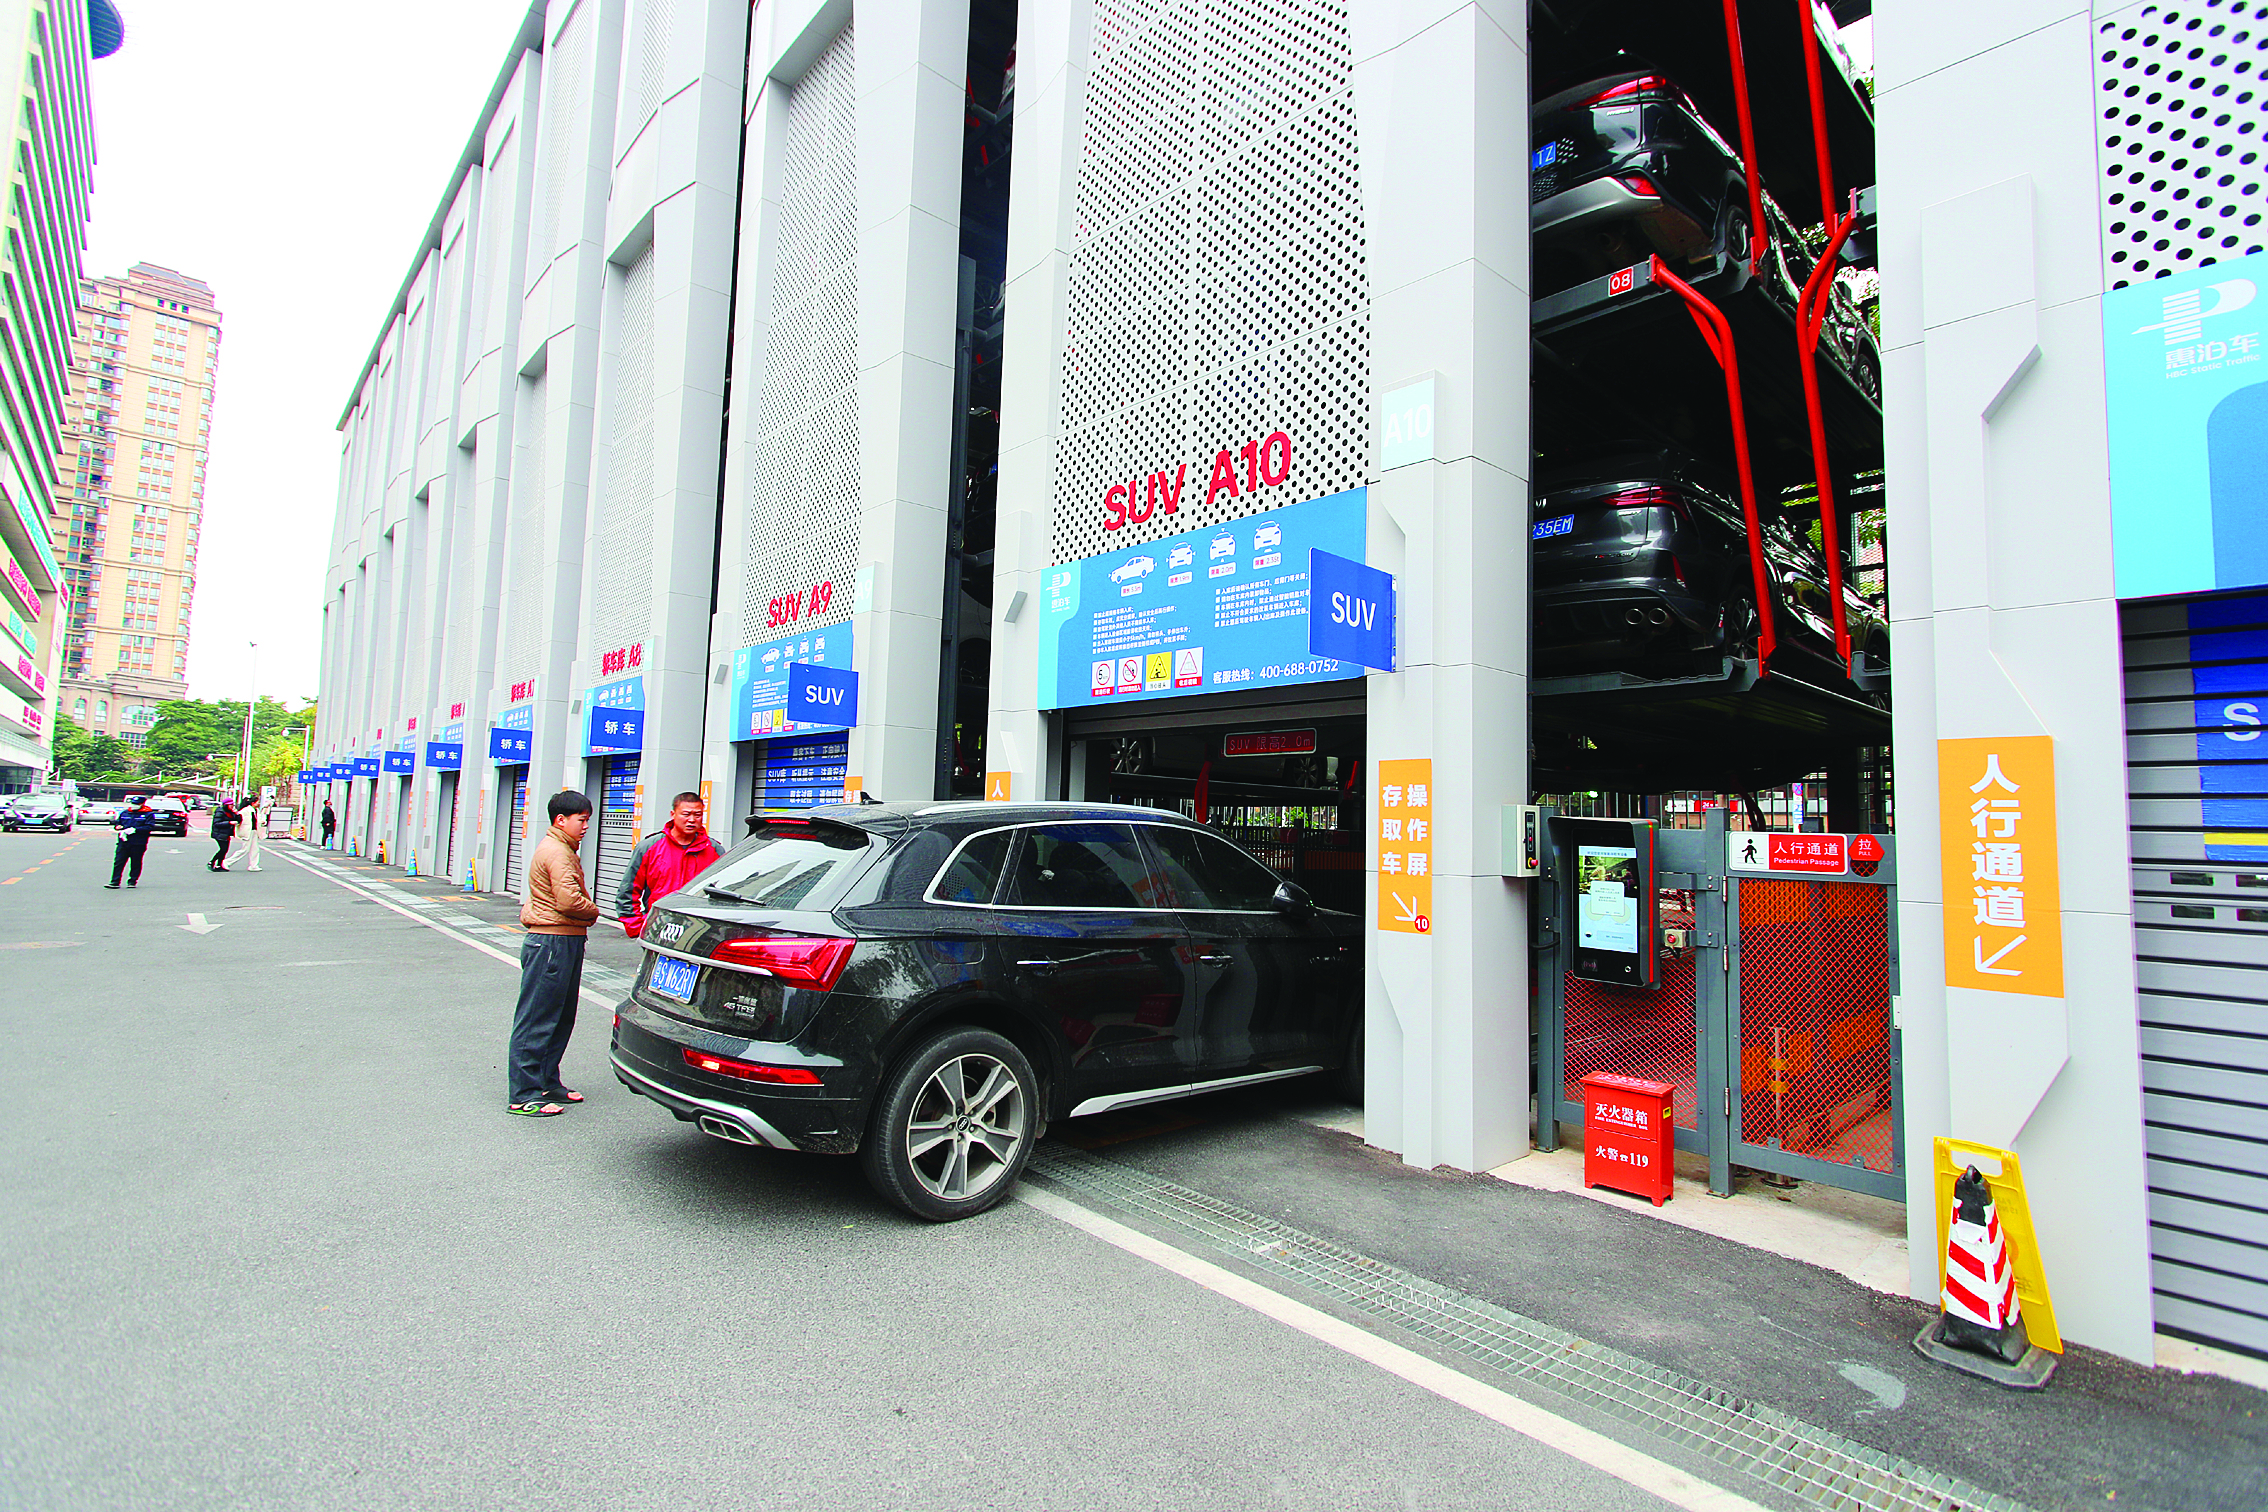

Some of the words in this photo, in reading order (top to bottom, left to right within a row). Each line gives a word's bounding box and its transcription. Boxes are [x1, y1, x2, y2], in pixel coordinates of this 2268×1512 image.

[1611, 274, 1630, 290] 08
[2166, 332, 2260, 369] 惠泊车
[2166, 369, 2188, 379] HBC
[2191, 361, 2222, 374] Static
[2226, 353, 2261, 367] Traffic
[1384, 404, 1431, 447] A10
[1104, 464, 1187, 531] SUV
[1206, 431, 1292, 505] A10
[855, 579, 872, 600] A9
[767, 590, 802, 628] SUV
[808, 580, 832, 617] A9
[1331, 591, 1376, 631] SUV
[1259, 659, 1339, 679] 400-688-0752
[805, 685, 844, 706] SUV
[604, 720, 636, 736] 轿车
[2223, 702, 2261, 741] S
[435, 750, 458, 760] 轿车
[501, 738, 527, 750] 轿车
[1230, 738, 1250, 751] SUV
[1382, 784, 1403, 875] 存取车
[1406, 784, 1428, 876] 操作屏
[1774, 841, 1839, 856] 人行通道
[1858, 839, 1872, 850] 拉
[1969, 754, 2026, 928] 人行通道
[1774, 857, 1809, 865] Pedestrian
[1810, 858, 1839, 867] Passage
[1416, 918, 1428, 930] 10
[1595, 1102, 1648, 1126] 灭火器箱
[1595, 1145, 1618, 1161] 火警
[1630, 1152, 1649, 1168] 119
